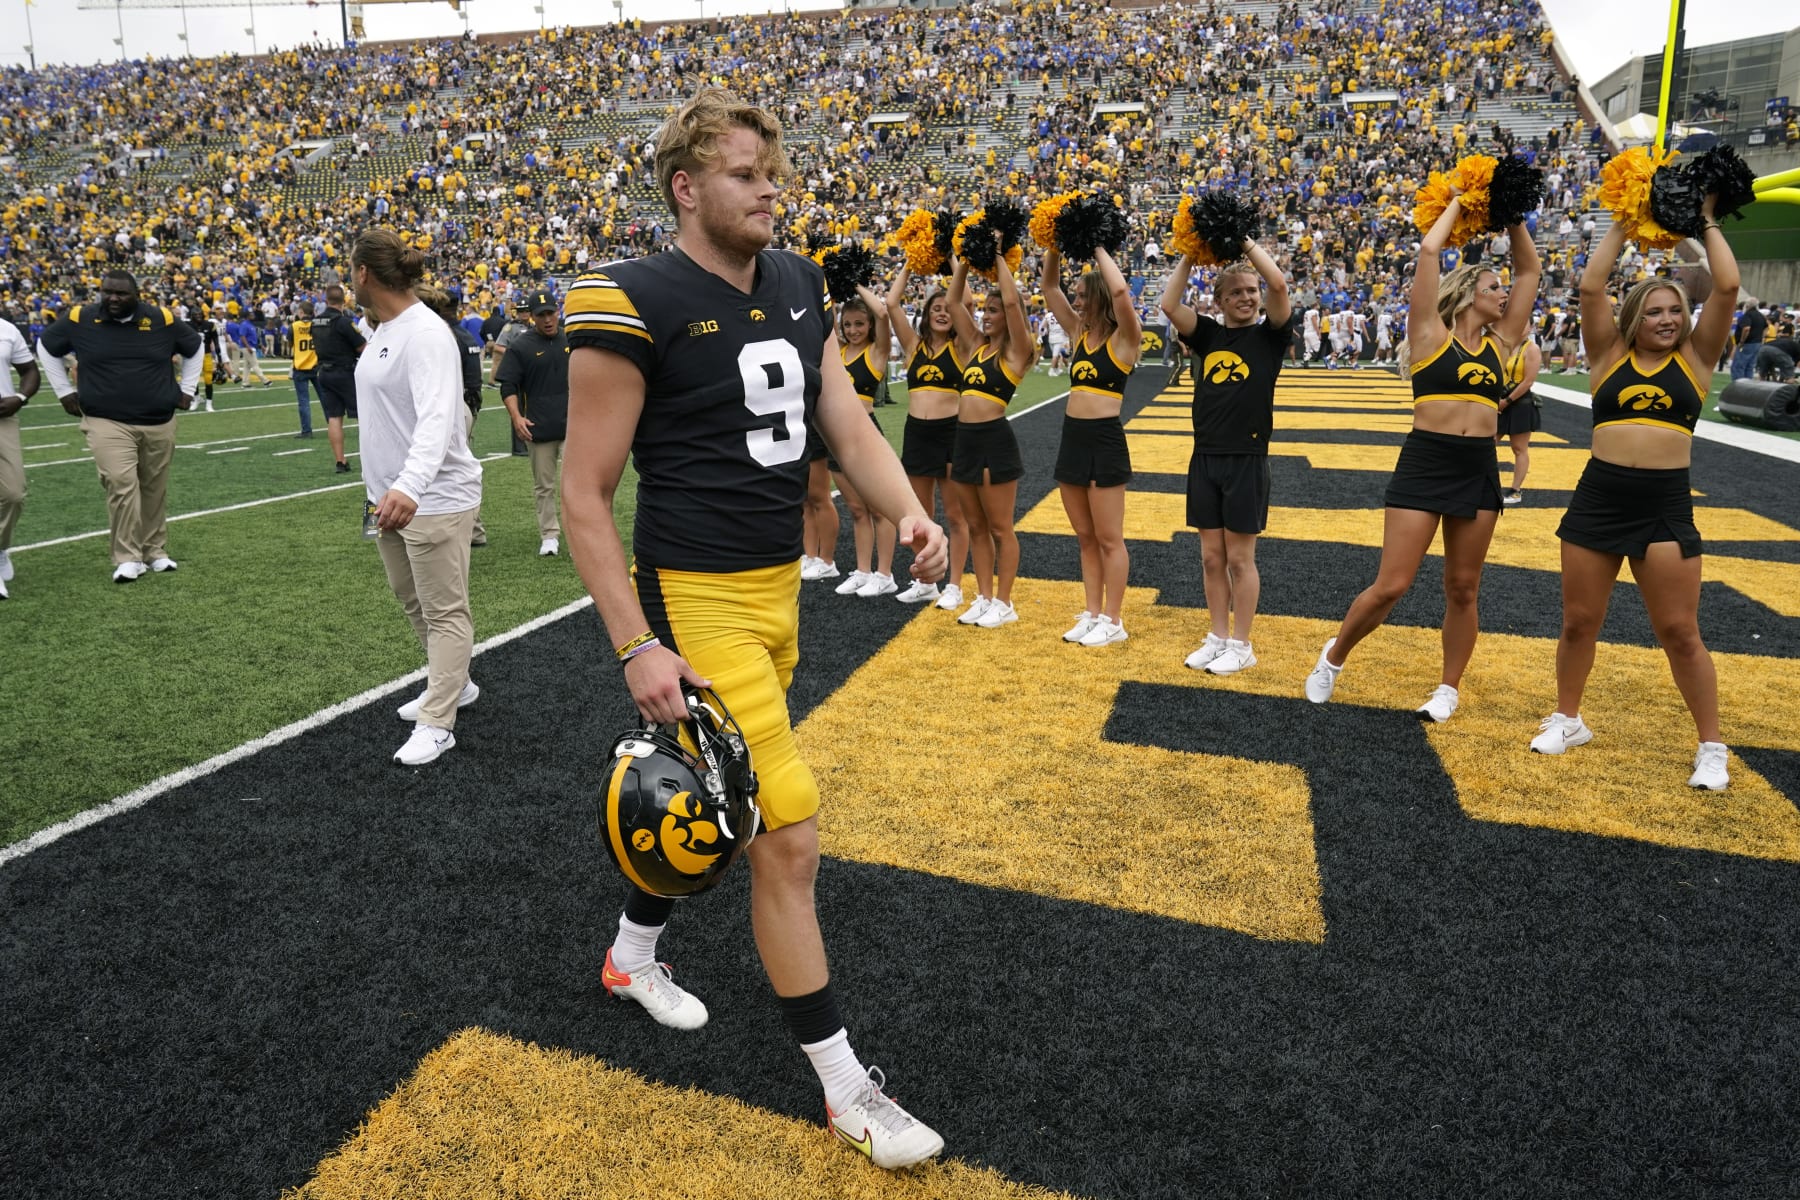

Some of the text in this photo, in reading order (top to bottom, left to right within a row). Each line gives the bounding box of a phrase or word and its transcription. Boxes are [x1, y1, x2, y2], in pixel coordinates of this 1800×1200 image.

[737, 338, 807, 468] 9
[700, 740, 718, 770] Riddll
[636, 832, 651, 848] ANF
